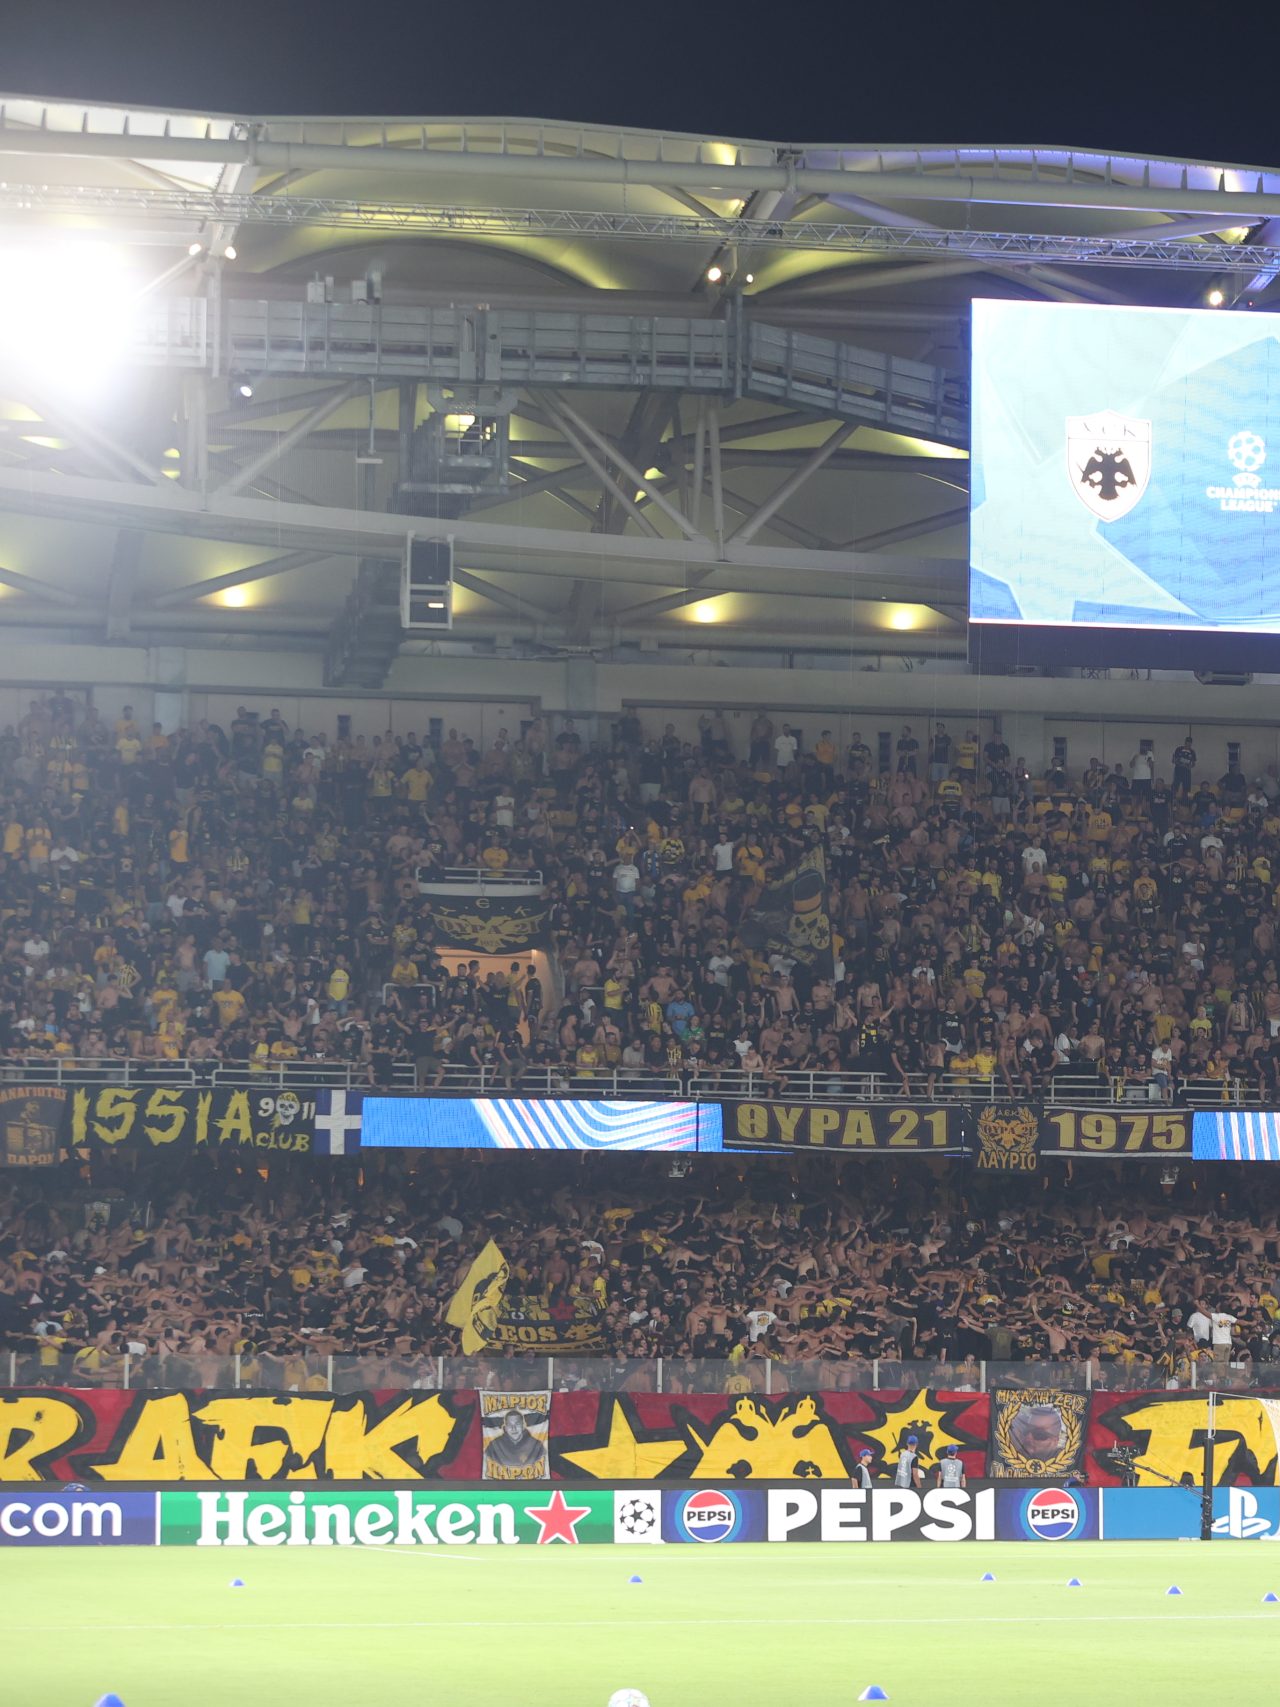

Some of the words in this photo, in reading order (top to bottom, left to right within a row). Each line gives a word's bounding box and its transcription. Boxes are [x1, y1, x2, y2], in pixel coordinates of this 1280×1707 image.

[1220, 499, 1274, 512] LEAGUE
[737, 1103, 876, 1143] ΘΥΡΑ
[888, 1109, 948, 1147] 21
[1049, 1111, 1187, 1151] 1975
[256, 1132, 310, 1152] CLUB
[977, 1150, 1037, 1171] ΛΑΥΡΙΟ
[483, 1394, 548, 1416] ΜΑΡΙΟΣ
[197, 1490, 519, 1546] Heineken
[686, 1509, 732, 1522] PEPSI
[767, 1488, 995, 1542] PEPSI
[1031, 1508, 1076, 1521] PEPSI
